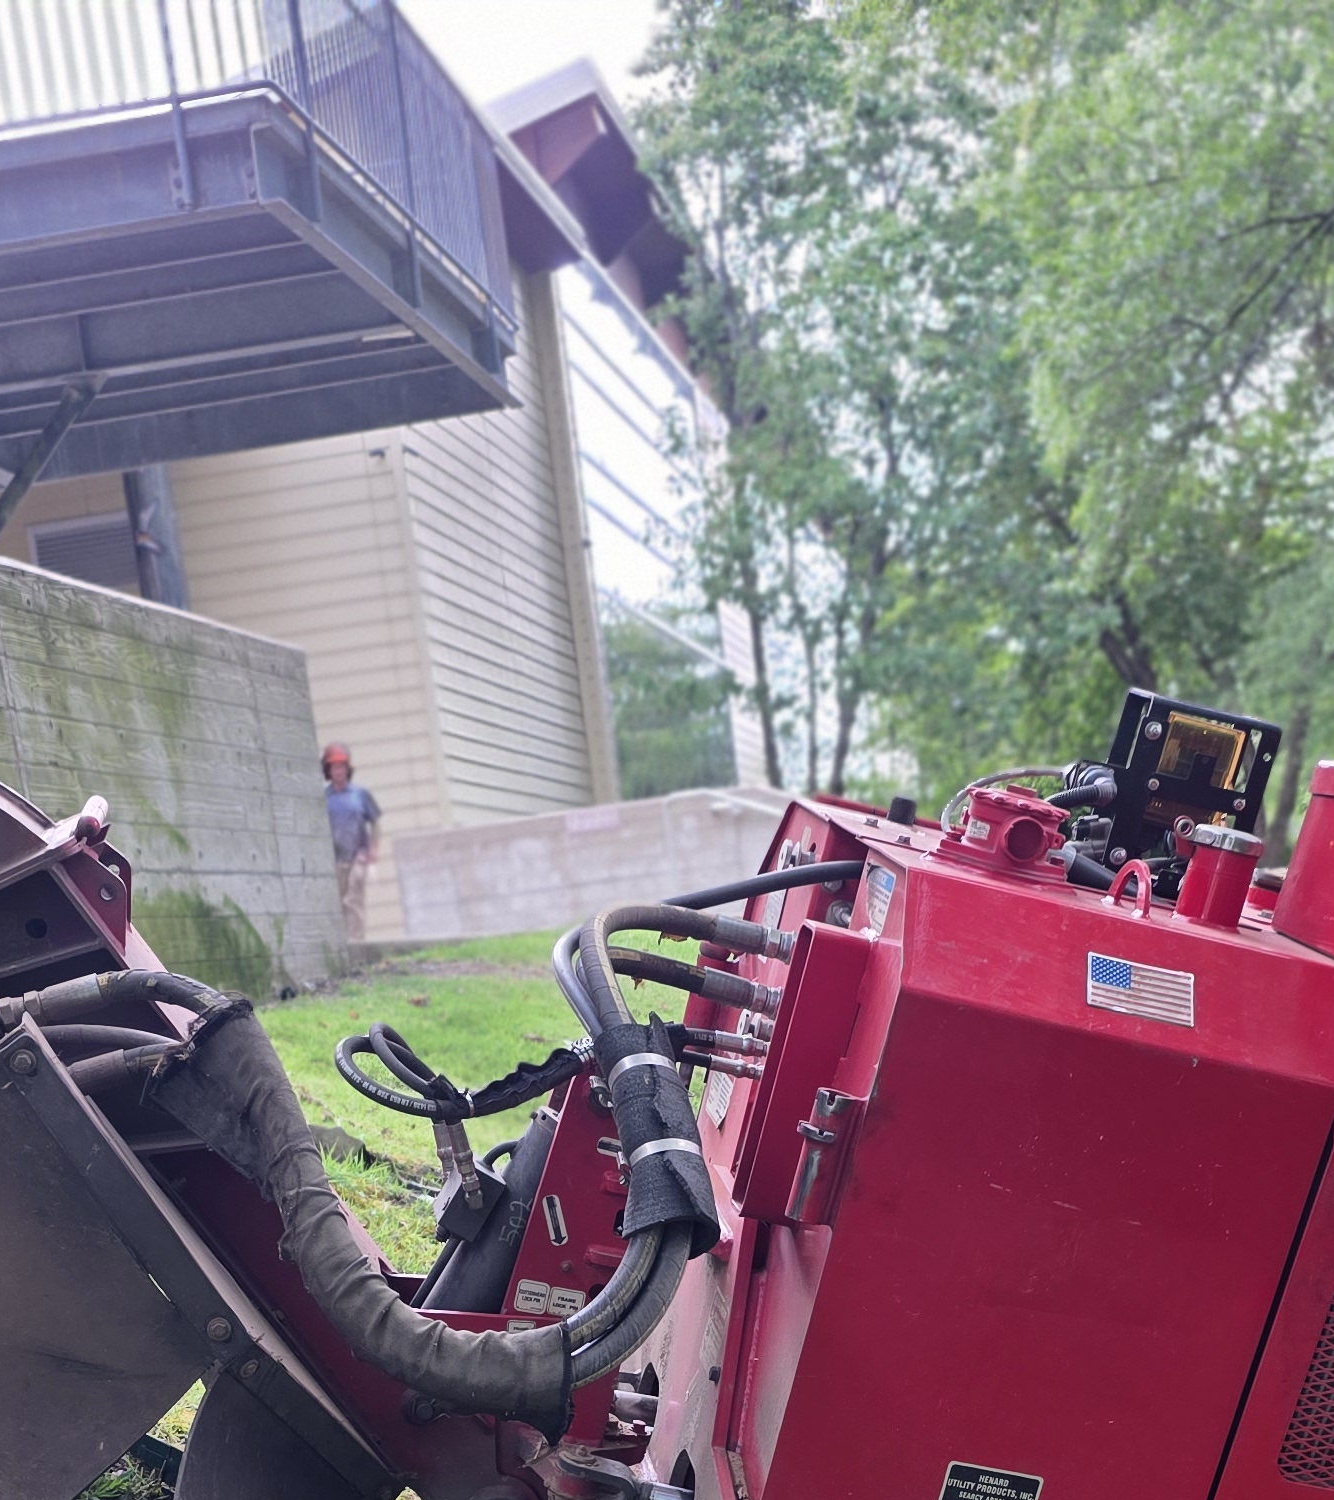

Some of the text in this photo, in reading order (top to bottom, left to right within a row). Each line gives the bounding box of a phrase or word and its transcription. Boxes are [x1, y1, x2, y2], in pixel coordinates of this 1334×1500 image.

[947, 1478, 975, 1490] UTILITY
[976, 1484, 1018, 1499] PRODUCTS,
[979, 1474, 1009, 1487] HENARD
